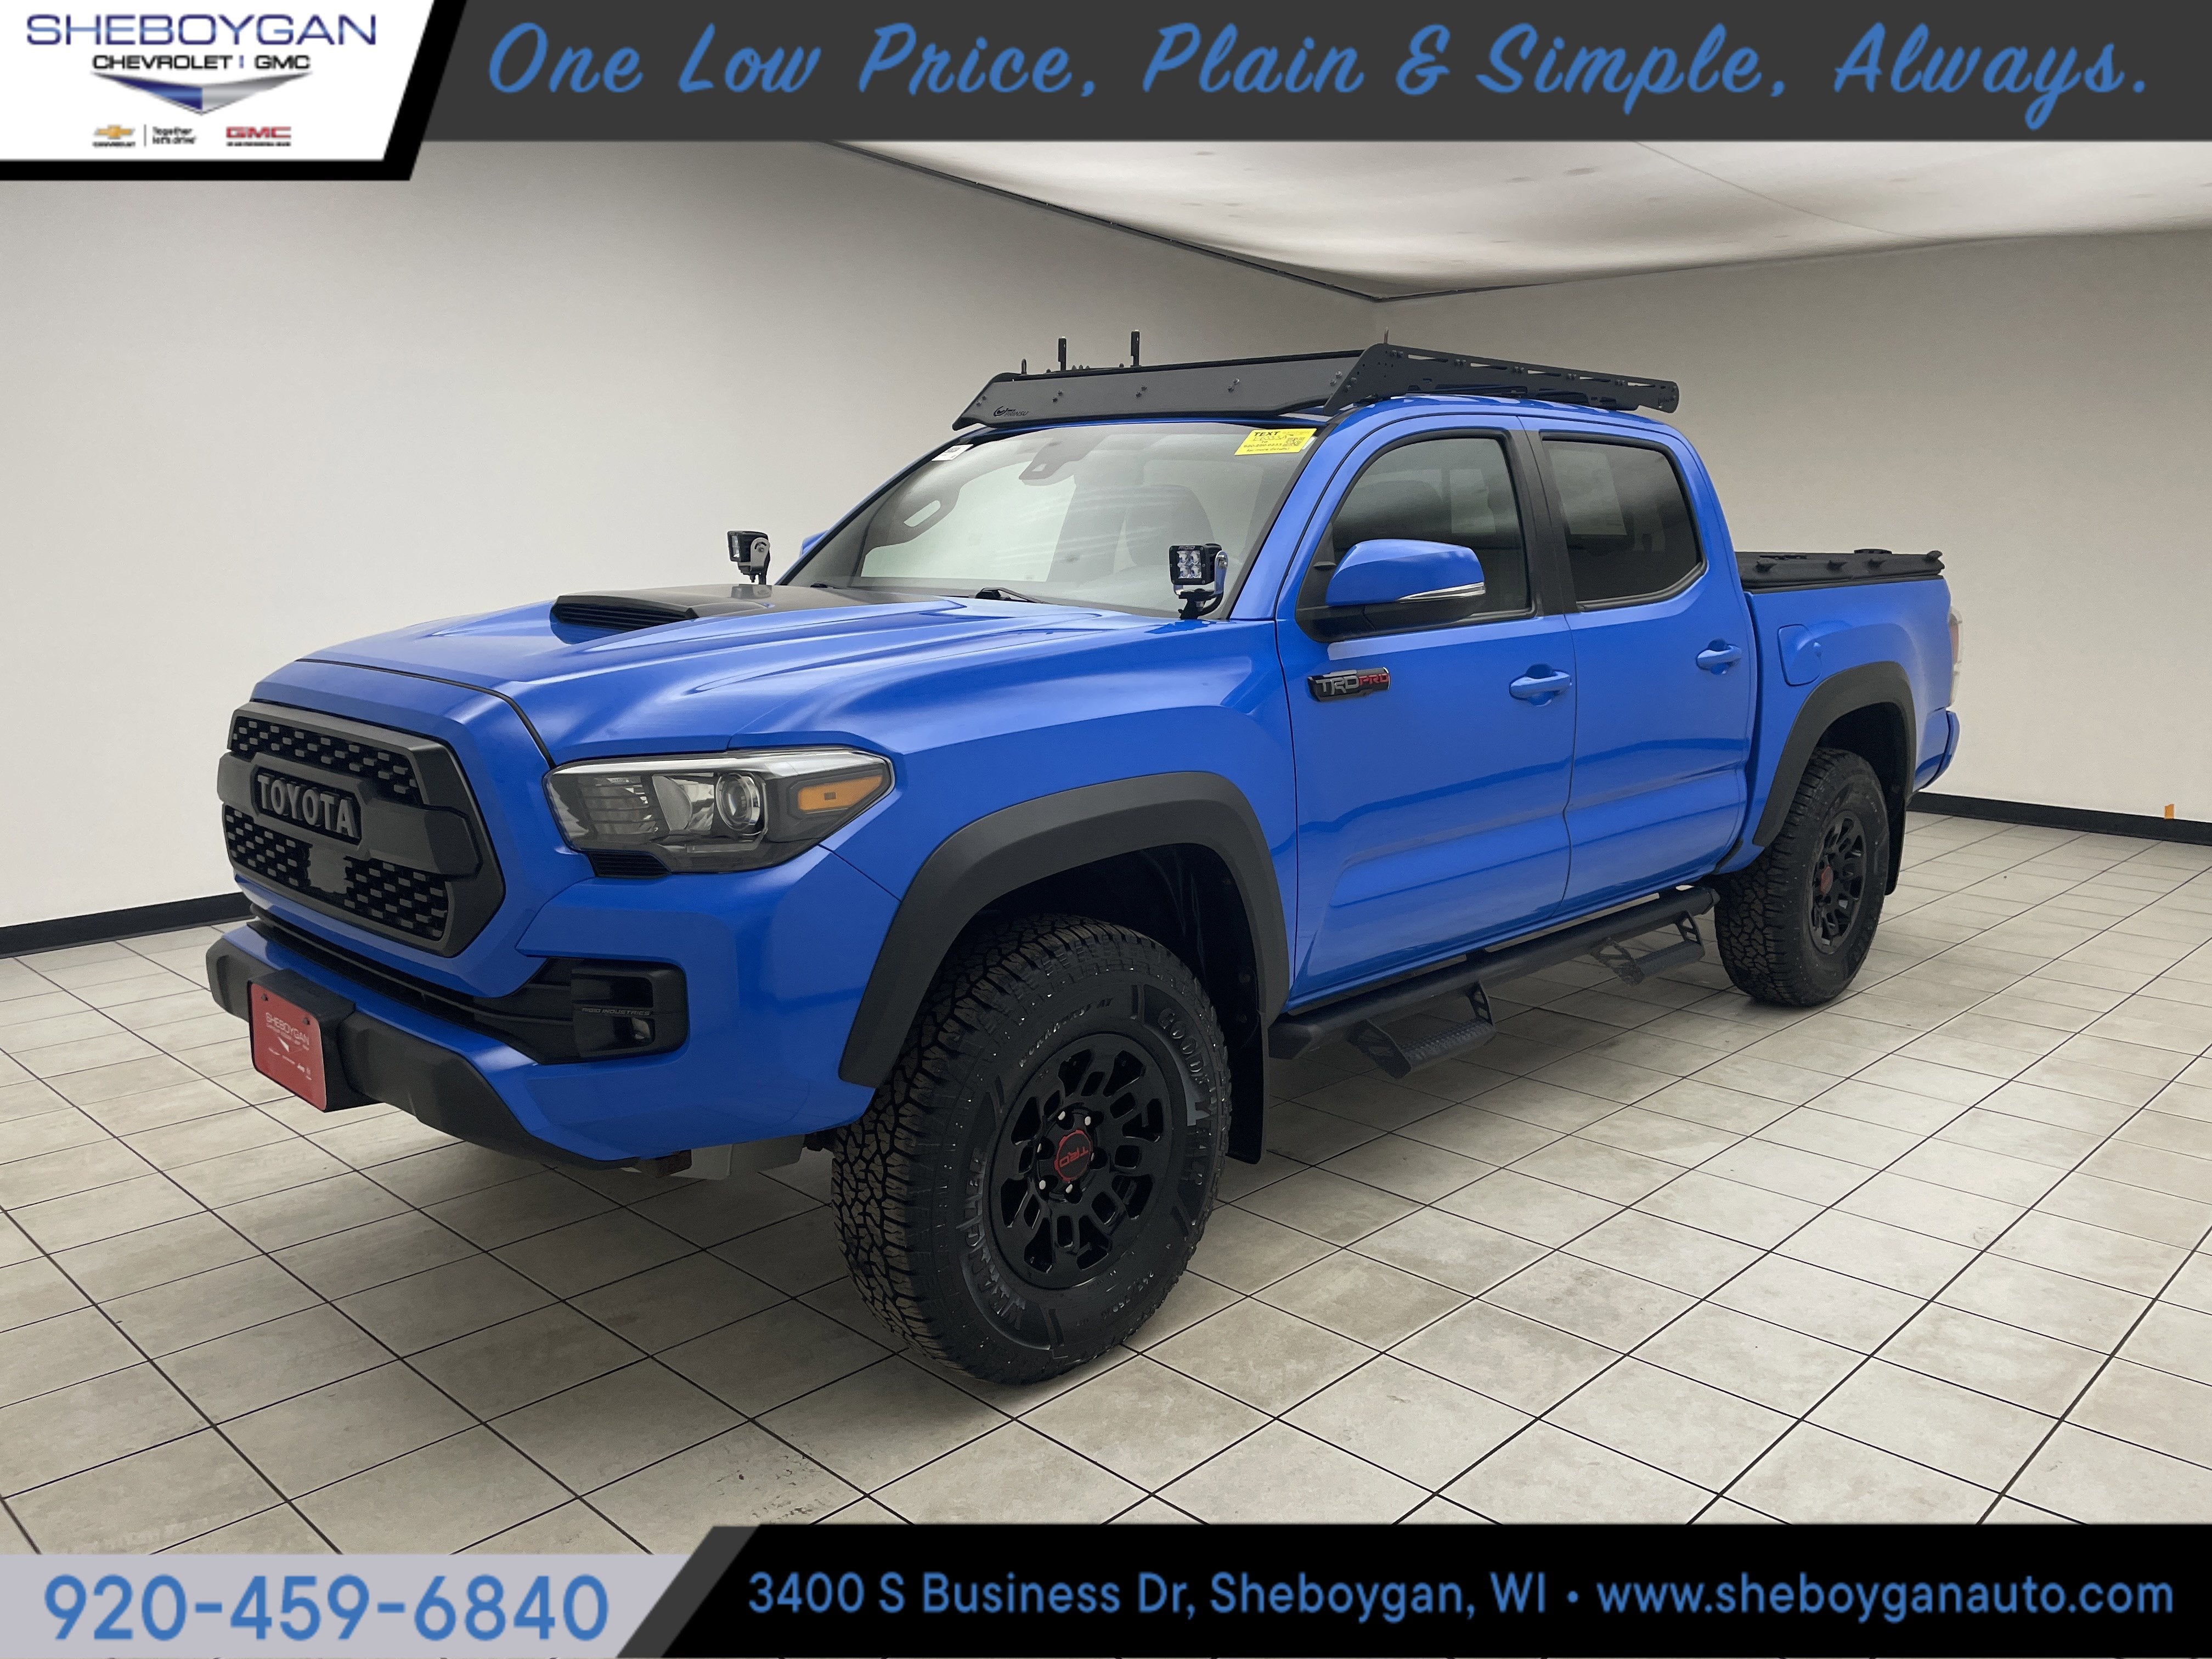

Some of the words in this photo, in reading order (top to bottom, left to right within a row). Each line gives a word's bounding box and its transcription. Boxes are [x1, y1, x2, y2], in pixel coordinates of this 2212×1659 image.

[1316, 675, 1359, 695] TRD
[1359, 673, 1390, 686] PRO
[257, 772, 357, 839] TOYOTA
[266, 1012, 310, 1046] SHEBOYGAN
[1058, 1146, 1089, 1169] TRD
